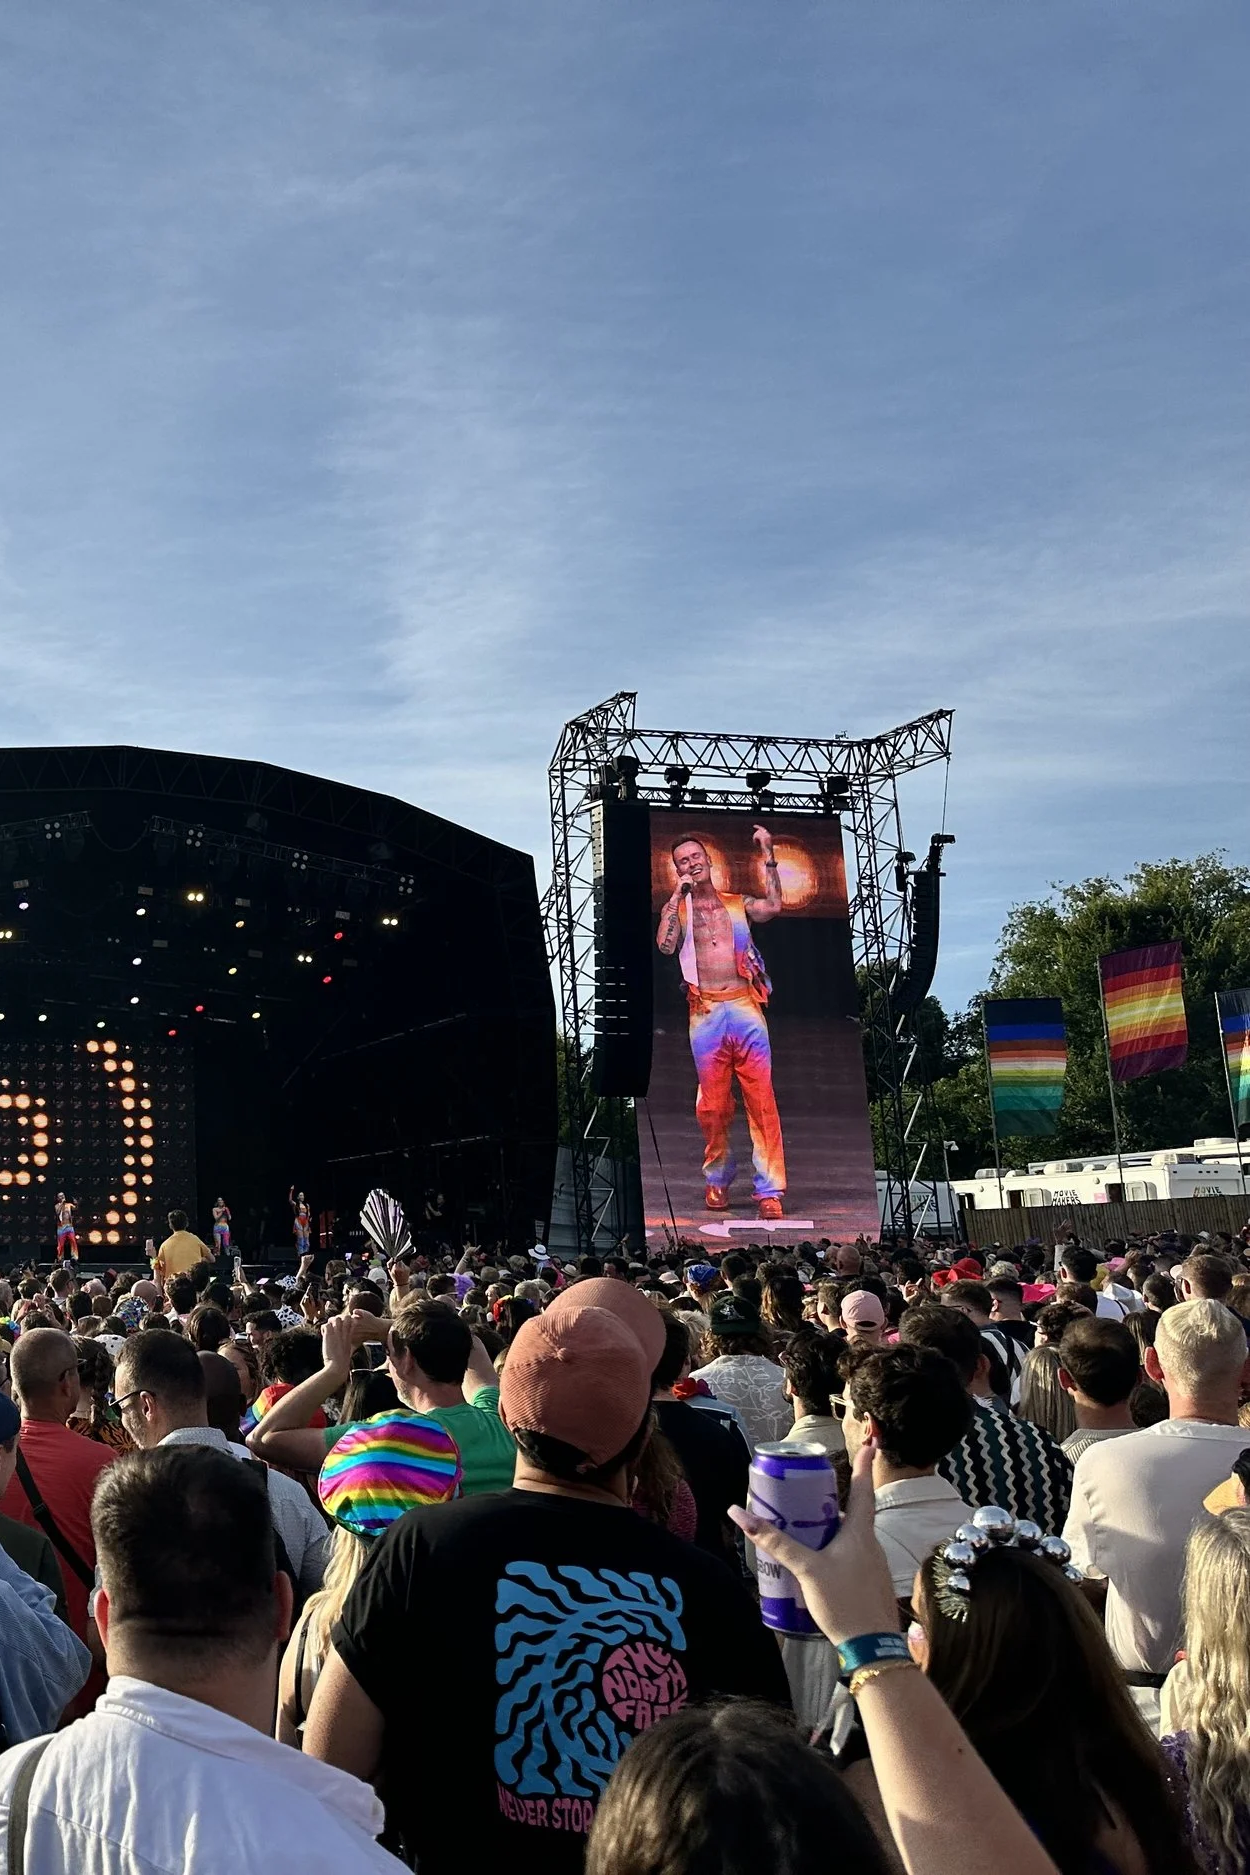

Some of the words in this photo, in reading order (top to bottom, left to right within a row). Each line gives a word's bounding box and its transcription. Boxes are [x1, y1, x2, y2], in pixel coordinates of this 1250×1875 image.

[1051, 1196, 1082, 1206] MAKERS
[1193, 1186, 1222, 1194] MOVIE
[603, 1642, 671, 1677] THE
[602, 1659, 687, 1705] NORTH
[496, 1780, 549, 1828] NEVER
[552, 1797, 594, 1834] STOP
